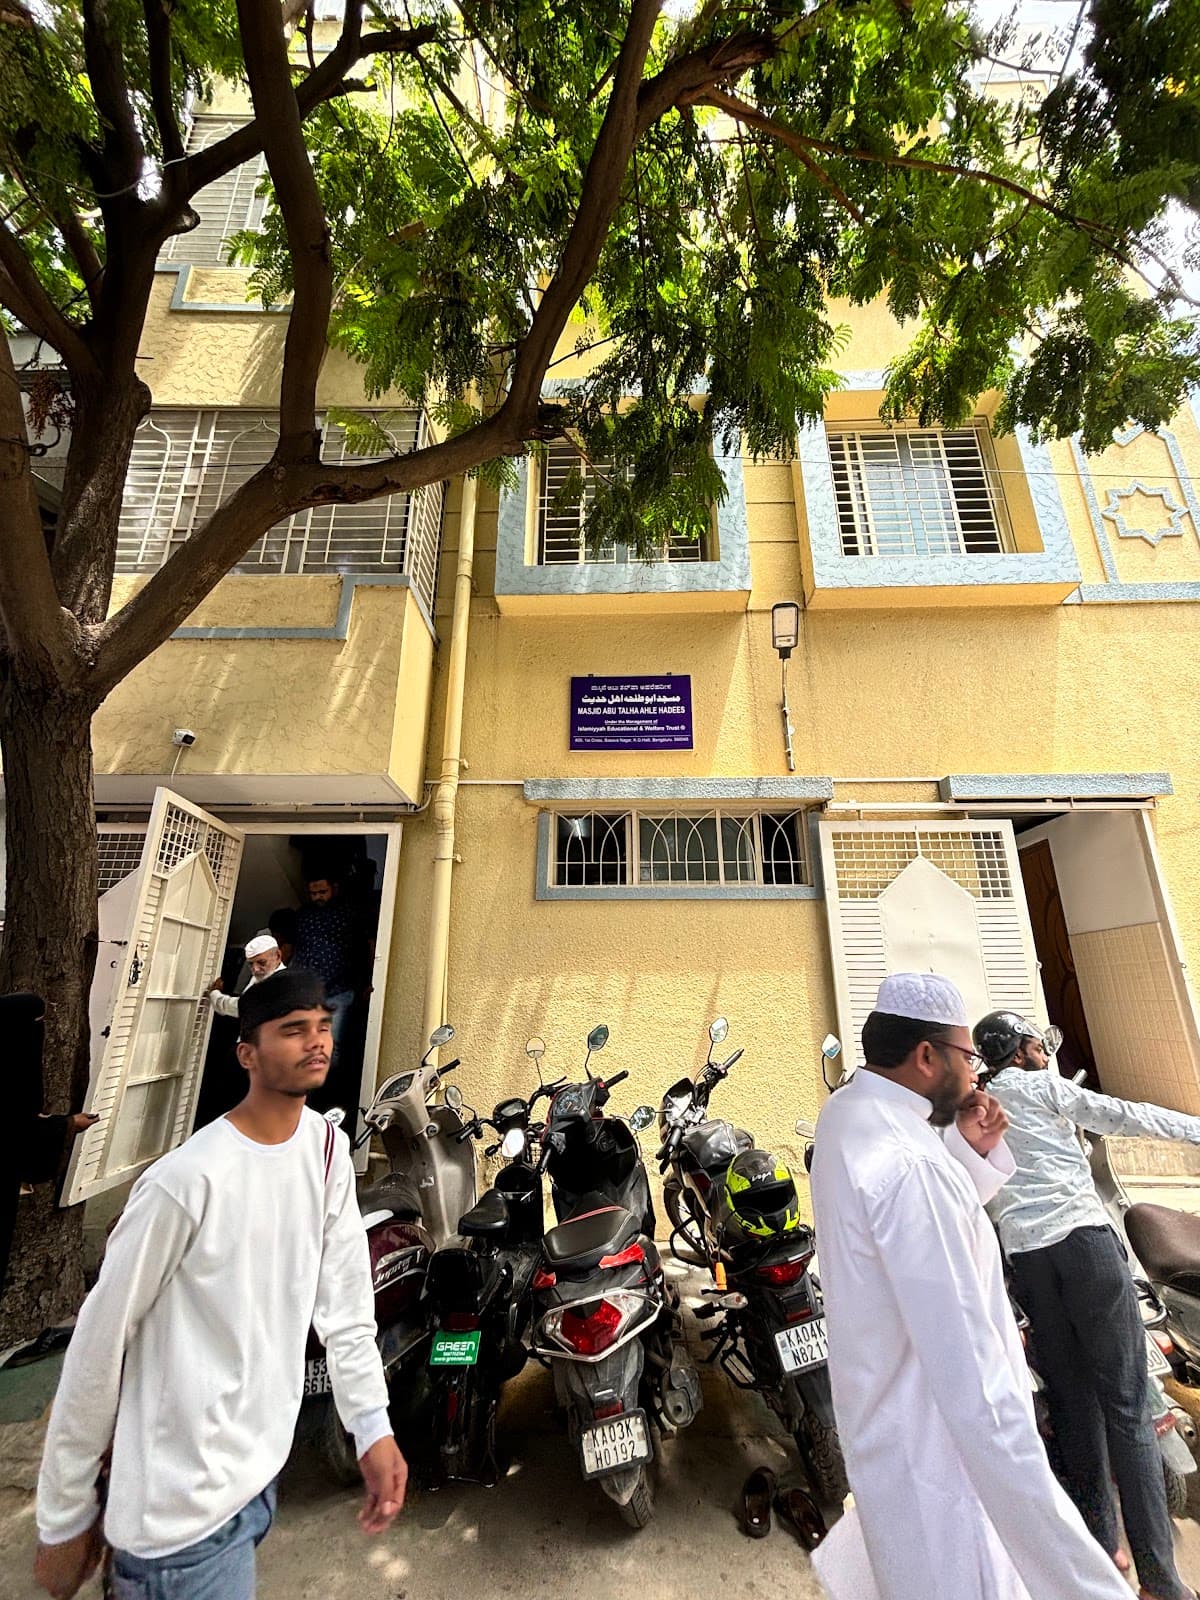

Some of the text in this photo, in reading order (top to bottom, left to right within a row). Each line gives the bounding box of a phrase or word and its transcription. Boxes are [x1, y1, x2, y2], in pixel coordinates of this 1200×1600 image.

[577, 705, 686, 715] MASJID ABU TALHA AHLE HADEES
[436, 1341, 476, 1352] GREEN
[785, 1319, 826, 1349] KA04K
[592, 1418, 633, 1449] KA03K
[594, 1440, 638, 1469] H0192
